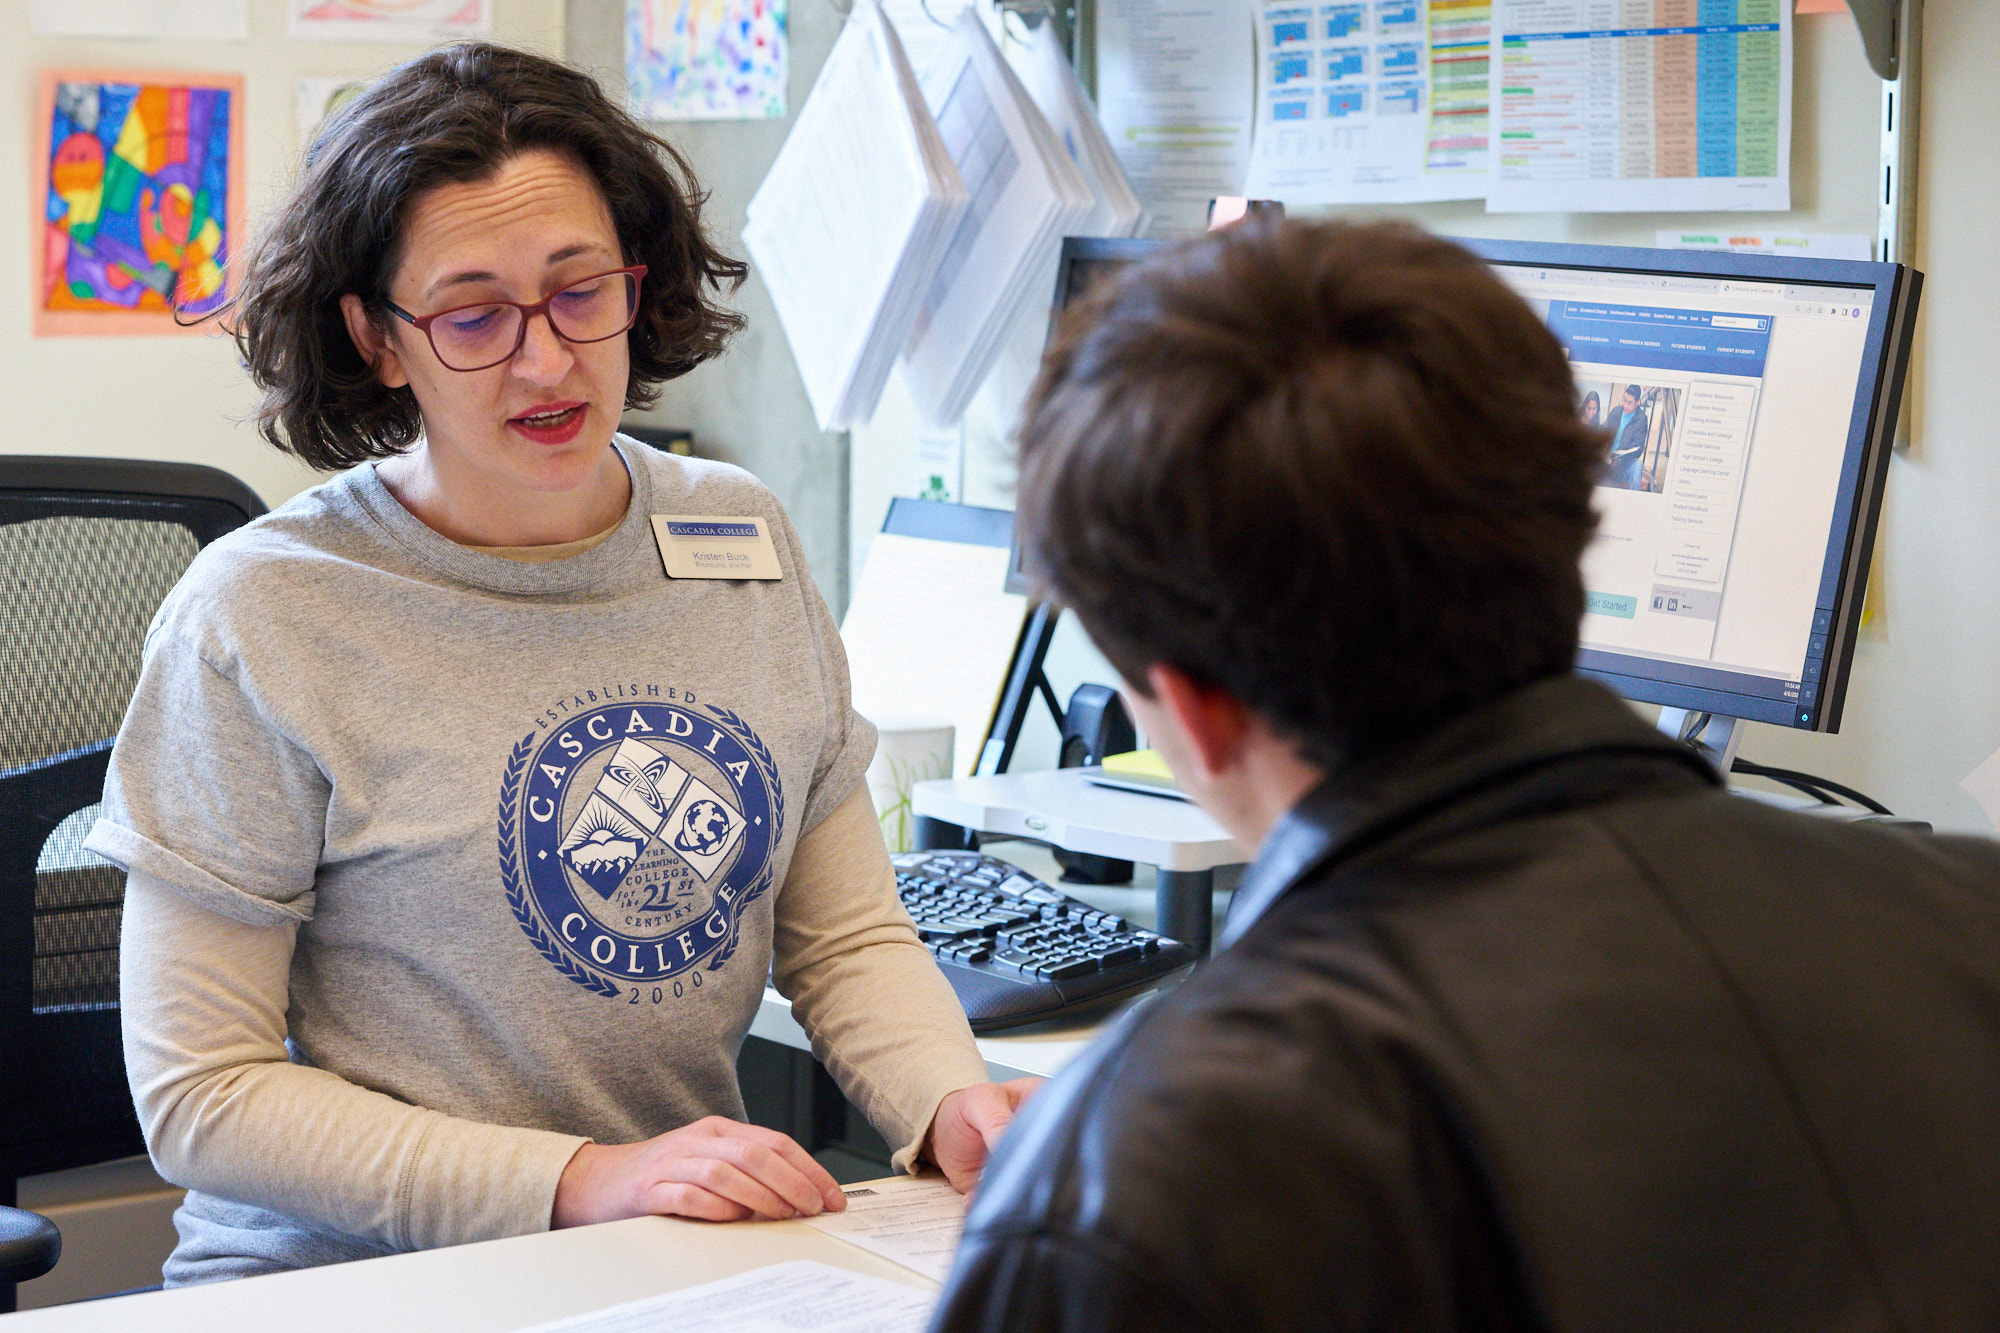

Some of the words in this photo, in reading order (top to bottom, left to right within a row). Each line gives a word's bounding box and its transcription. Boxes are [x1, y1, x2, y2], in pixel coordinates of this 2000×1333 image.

[670, 526, 716, 535] CASCADIA
[718, 527, 758, 536] COLLEGE
[693, 552, 724, 561] Kristen
[726, 552, 750, 561] Buck
[1602, 600, 1627, 611] Started
[534, 684, 696, 730] ESTABLISHED
[529, 708, 750, 823] CASCADIA
[646, 848, 666, 857] THE
[634, 858, 679, 871] LEARNING
[626, 868, 689, 886] COLLEGE
[616, 890, 635, 902] for
[621, 899, 639, 908] the
[626, 903, 692, 927] CENTURY
[562, 882, 737, 974] COLLEGE
[628, 970, 703, 1005] 2000
